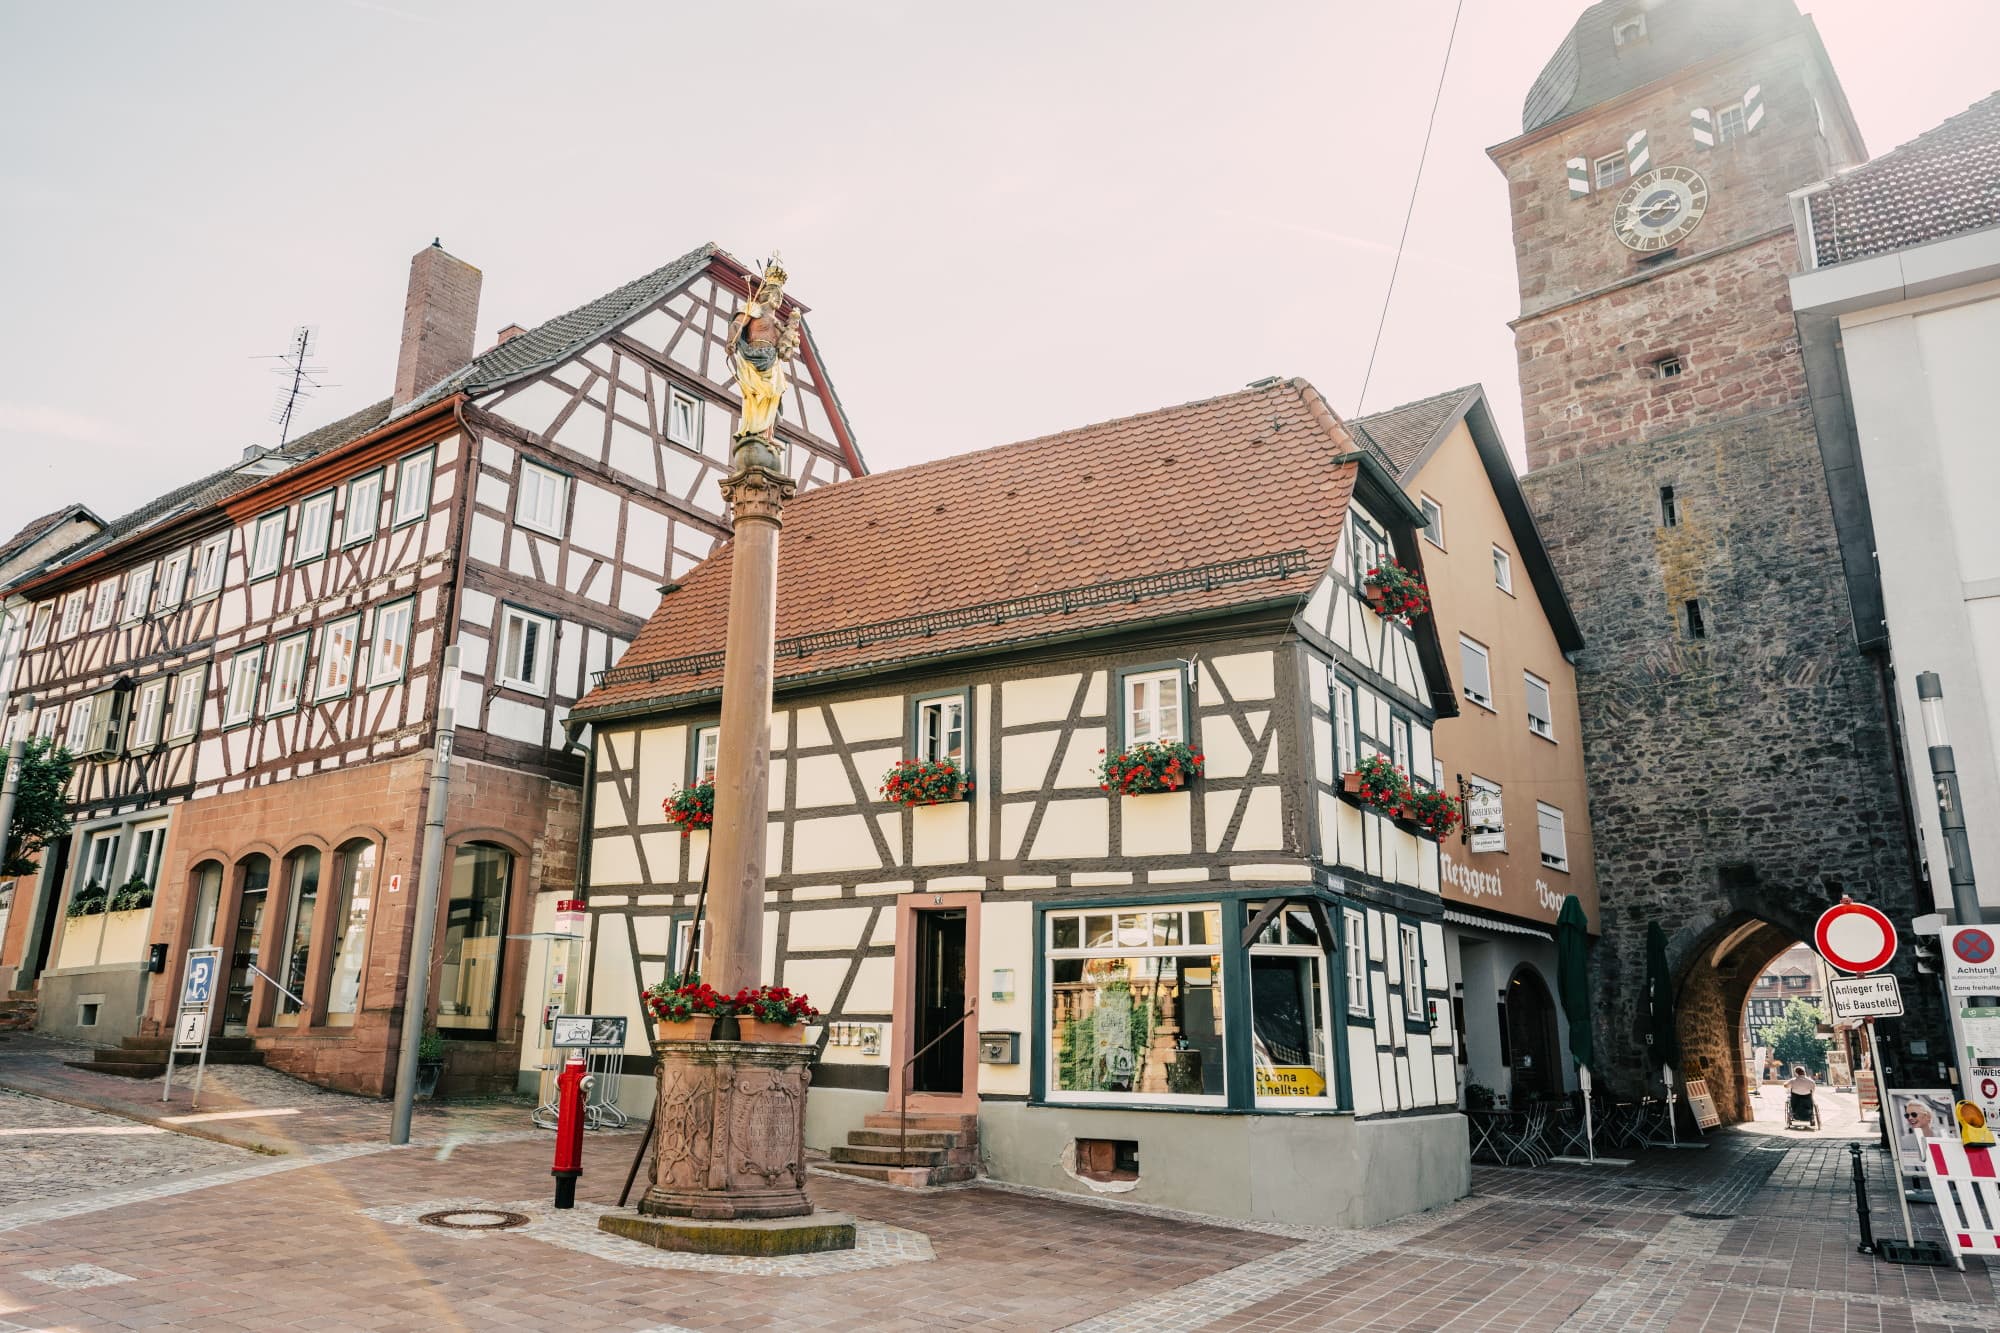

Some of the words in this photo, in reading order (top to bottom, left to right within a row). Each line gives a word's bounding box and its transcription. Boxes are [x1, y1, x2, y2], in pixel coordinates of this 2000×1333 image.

[1957, 966, 1997, 975] Achtung!
[1835, 983, 1873, 996] Anlieger
[1876, 982, 1893, 993] frei
[1837, 1000, 1851, 1011] bis
[1853, 997, 1898, 1010] Baustelle
